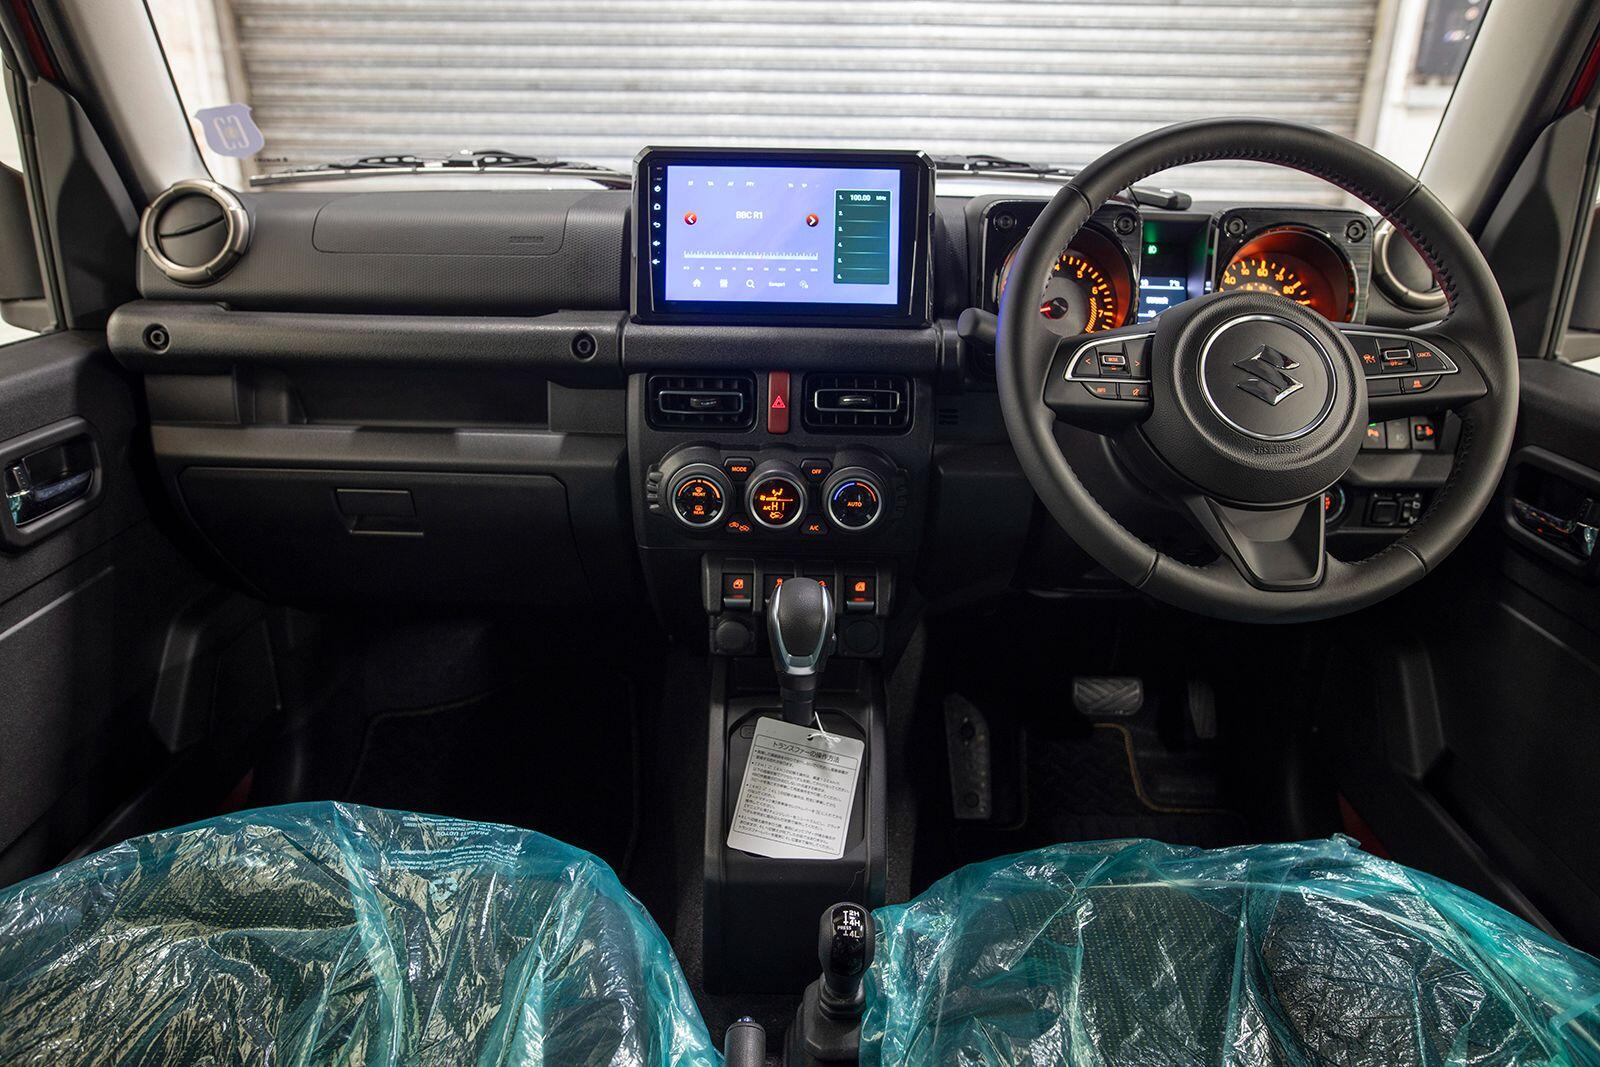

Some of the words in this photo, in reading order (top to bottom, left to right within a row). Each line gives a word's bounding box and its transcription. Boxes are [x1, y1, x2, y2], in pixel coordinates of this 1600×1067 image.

[736, 210, 752, 219] BBC
[753, 211, 763, 219] R1
[1077, 270, 1083, 278] 5
[1257, 268, 1268, 277] 60
[1224, 276, 1236, 285] 40
[1092, 286, 1098, 295] 6
[1283, 286, 1294, 294] 80
[1098, 309, 1103, 317] 7
[772, 740, 840, 764] トランスファーの操作方法
[849, 930, 860, 938] 4L
